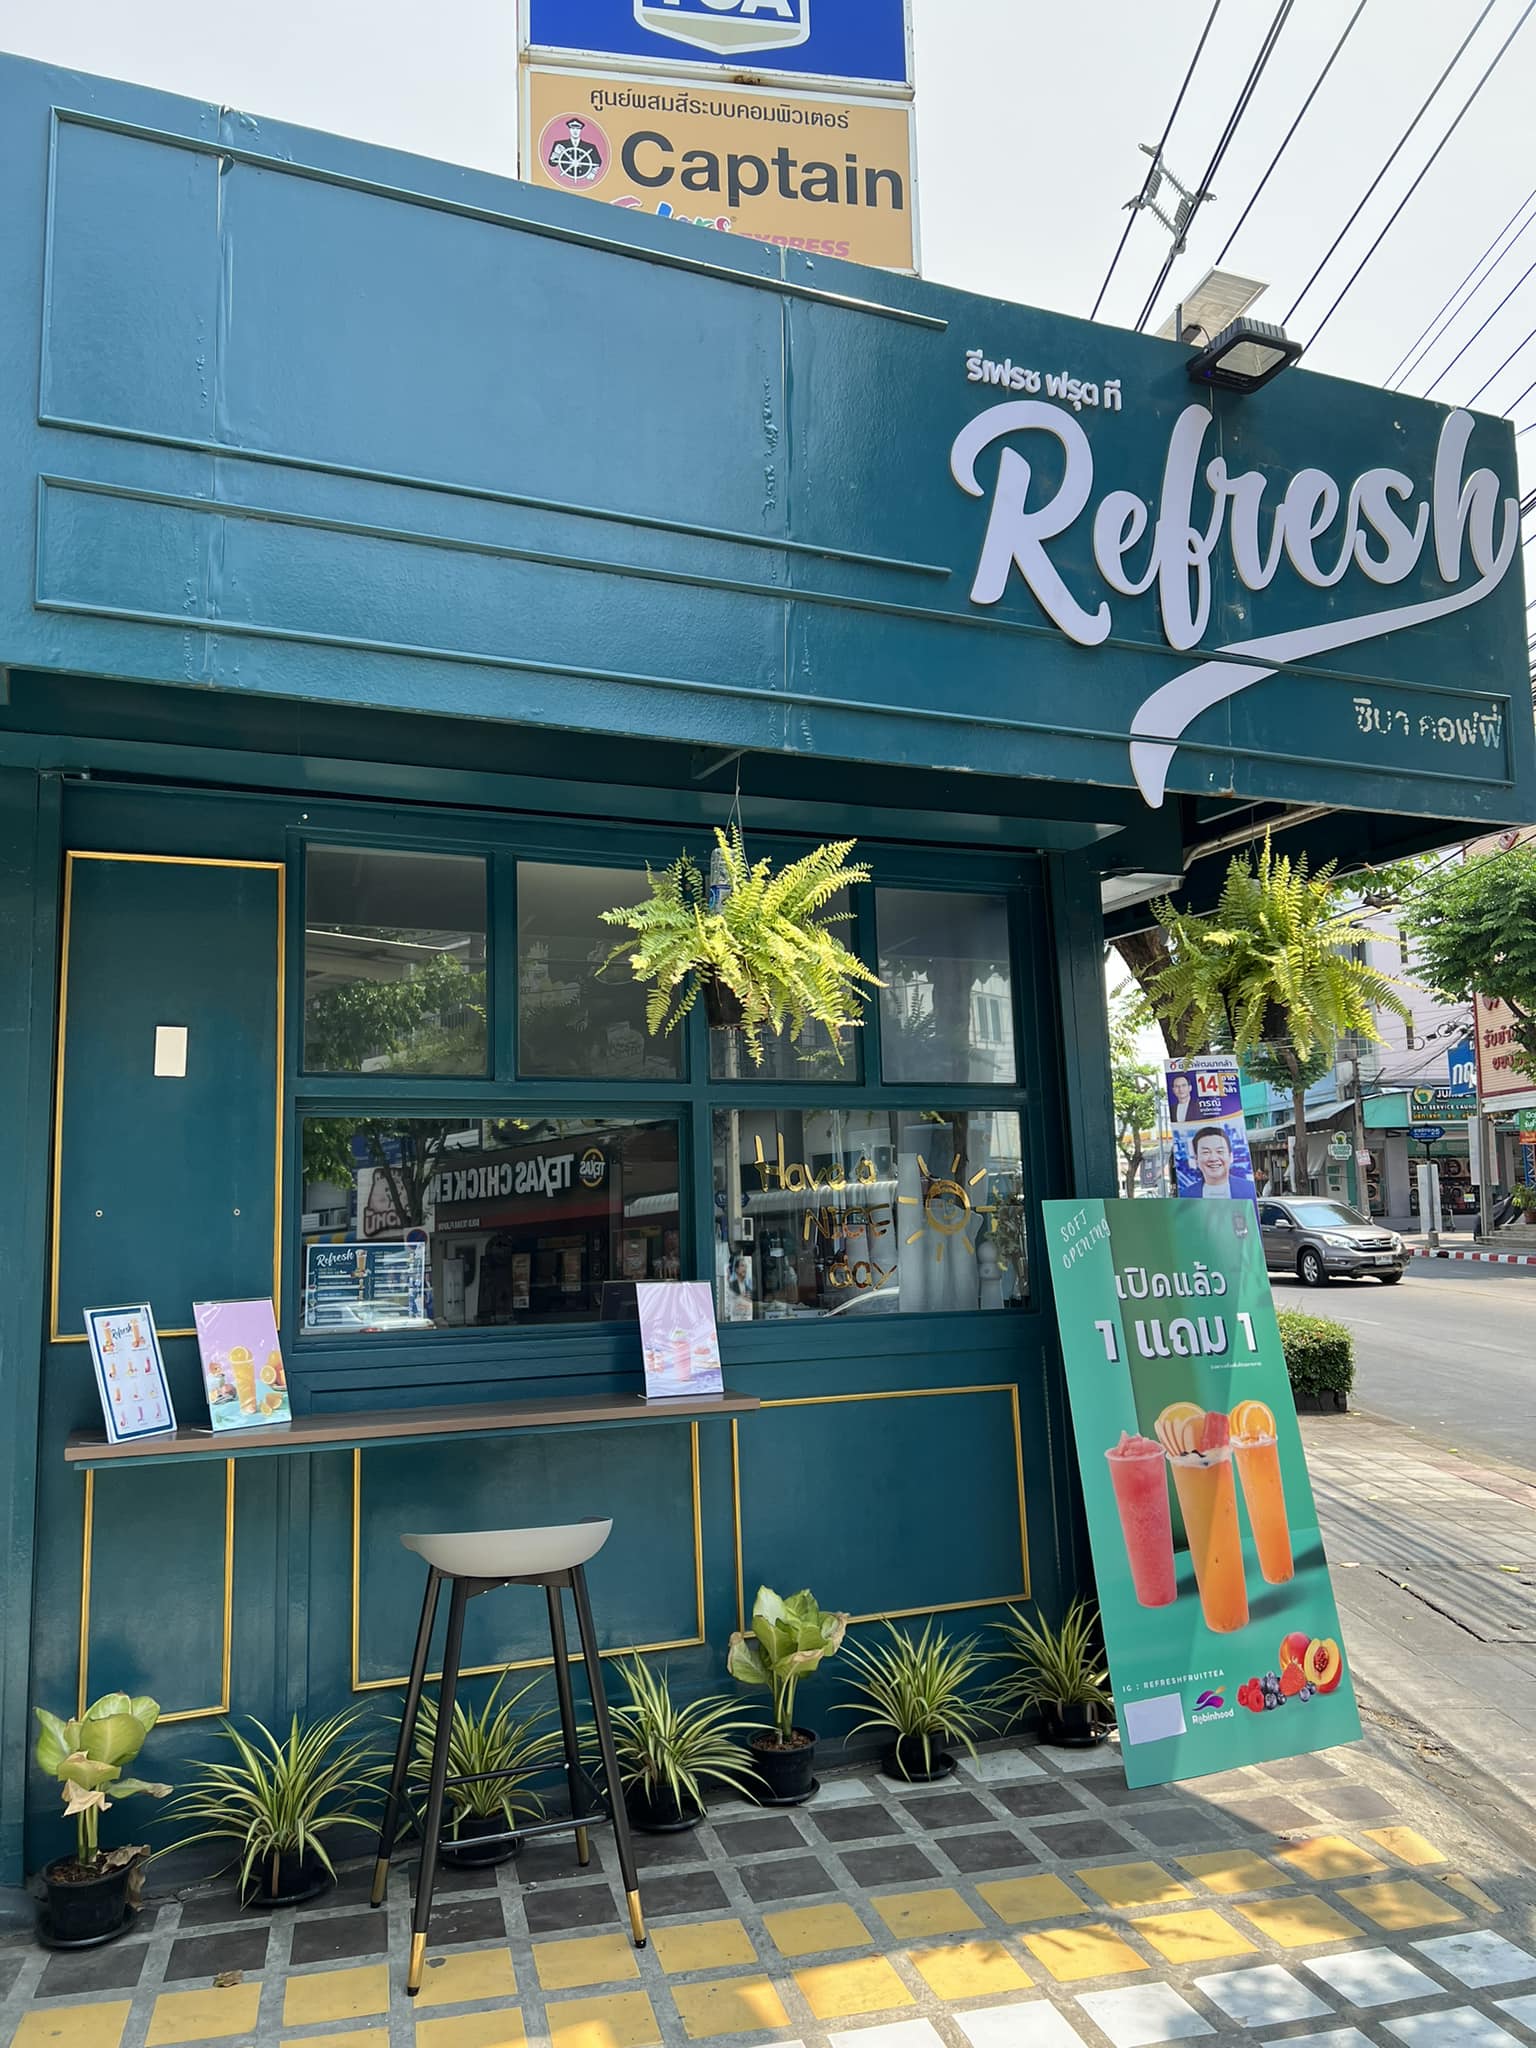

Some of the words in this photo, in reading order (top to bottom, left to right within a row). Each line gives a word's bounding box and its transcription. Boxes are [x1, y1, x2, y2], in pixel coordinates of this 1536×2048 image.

[621, 130, 903, 209] Captain
[965, 348, 1041, 393] รีเฟรช
[1045, 371, 1099, 411] ฟรุต
[1103, 378, 1122, 411] ที
[950, 400, 1521, 808] Refresh
[1197, 1075, 1217, 1093] 14
[754, 1132, 846, 1193] Have
[856, 1156, 877, 1185] a
[803, 1203, 890, 1241] NICE
[1060, 1208, 1087, 1243] SOFT
[316, 1248, 355, 1267] Refresh
[828, 1253, 897, 1291] day
[1114, 1261, 1227, 1299] เปิดแล้ว
[1094, 1319, 1119, 1361] 1
[1134, 1316, 1228, 1359] แถม
[1236, 1312, 1257, 1351] 1
[1122, 1684, 1132, 1693] IG
[1191, 1708, 1234, 1725] Robinhood
